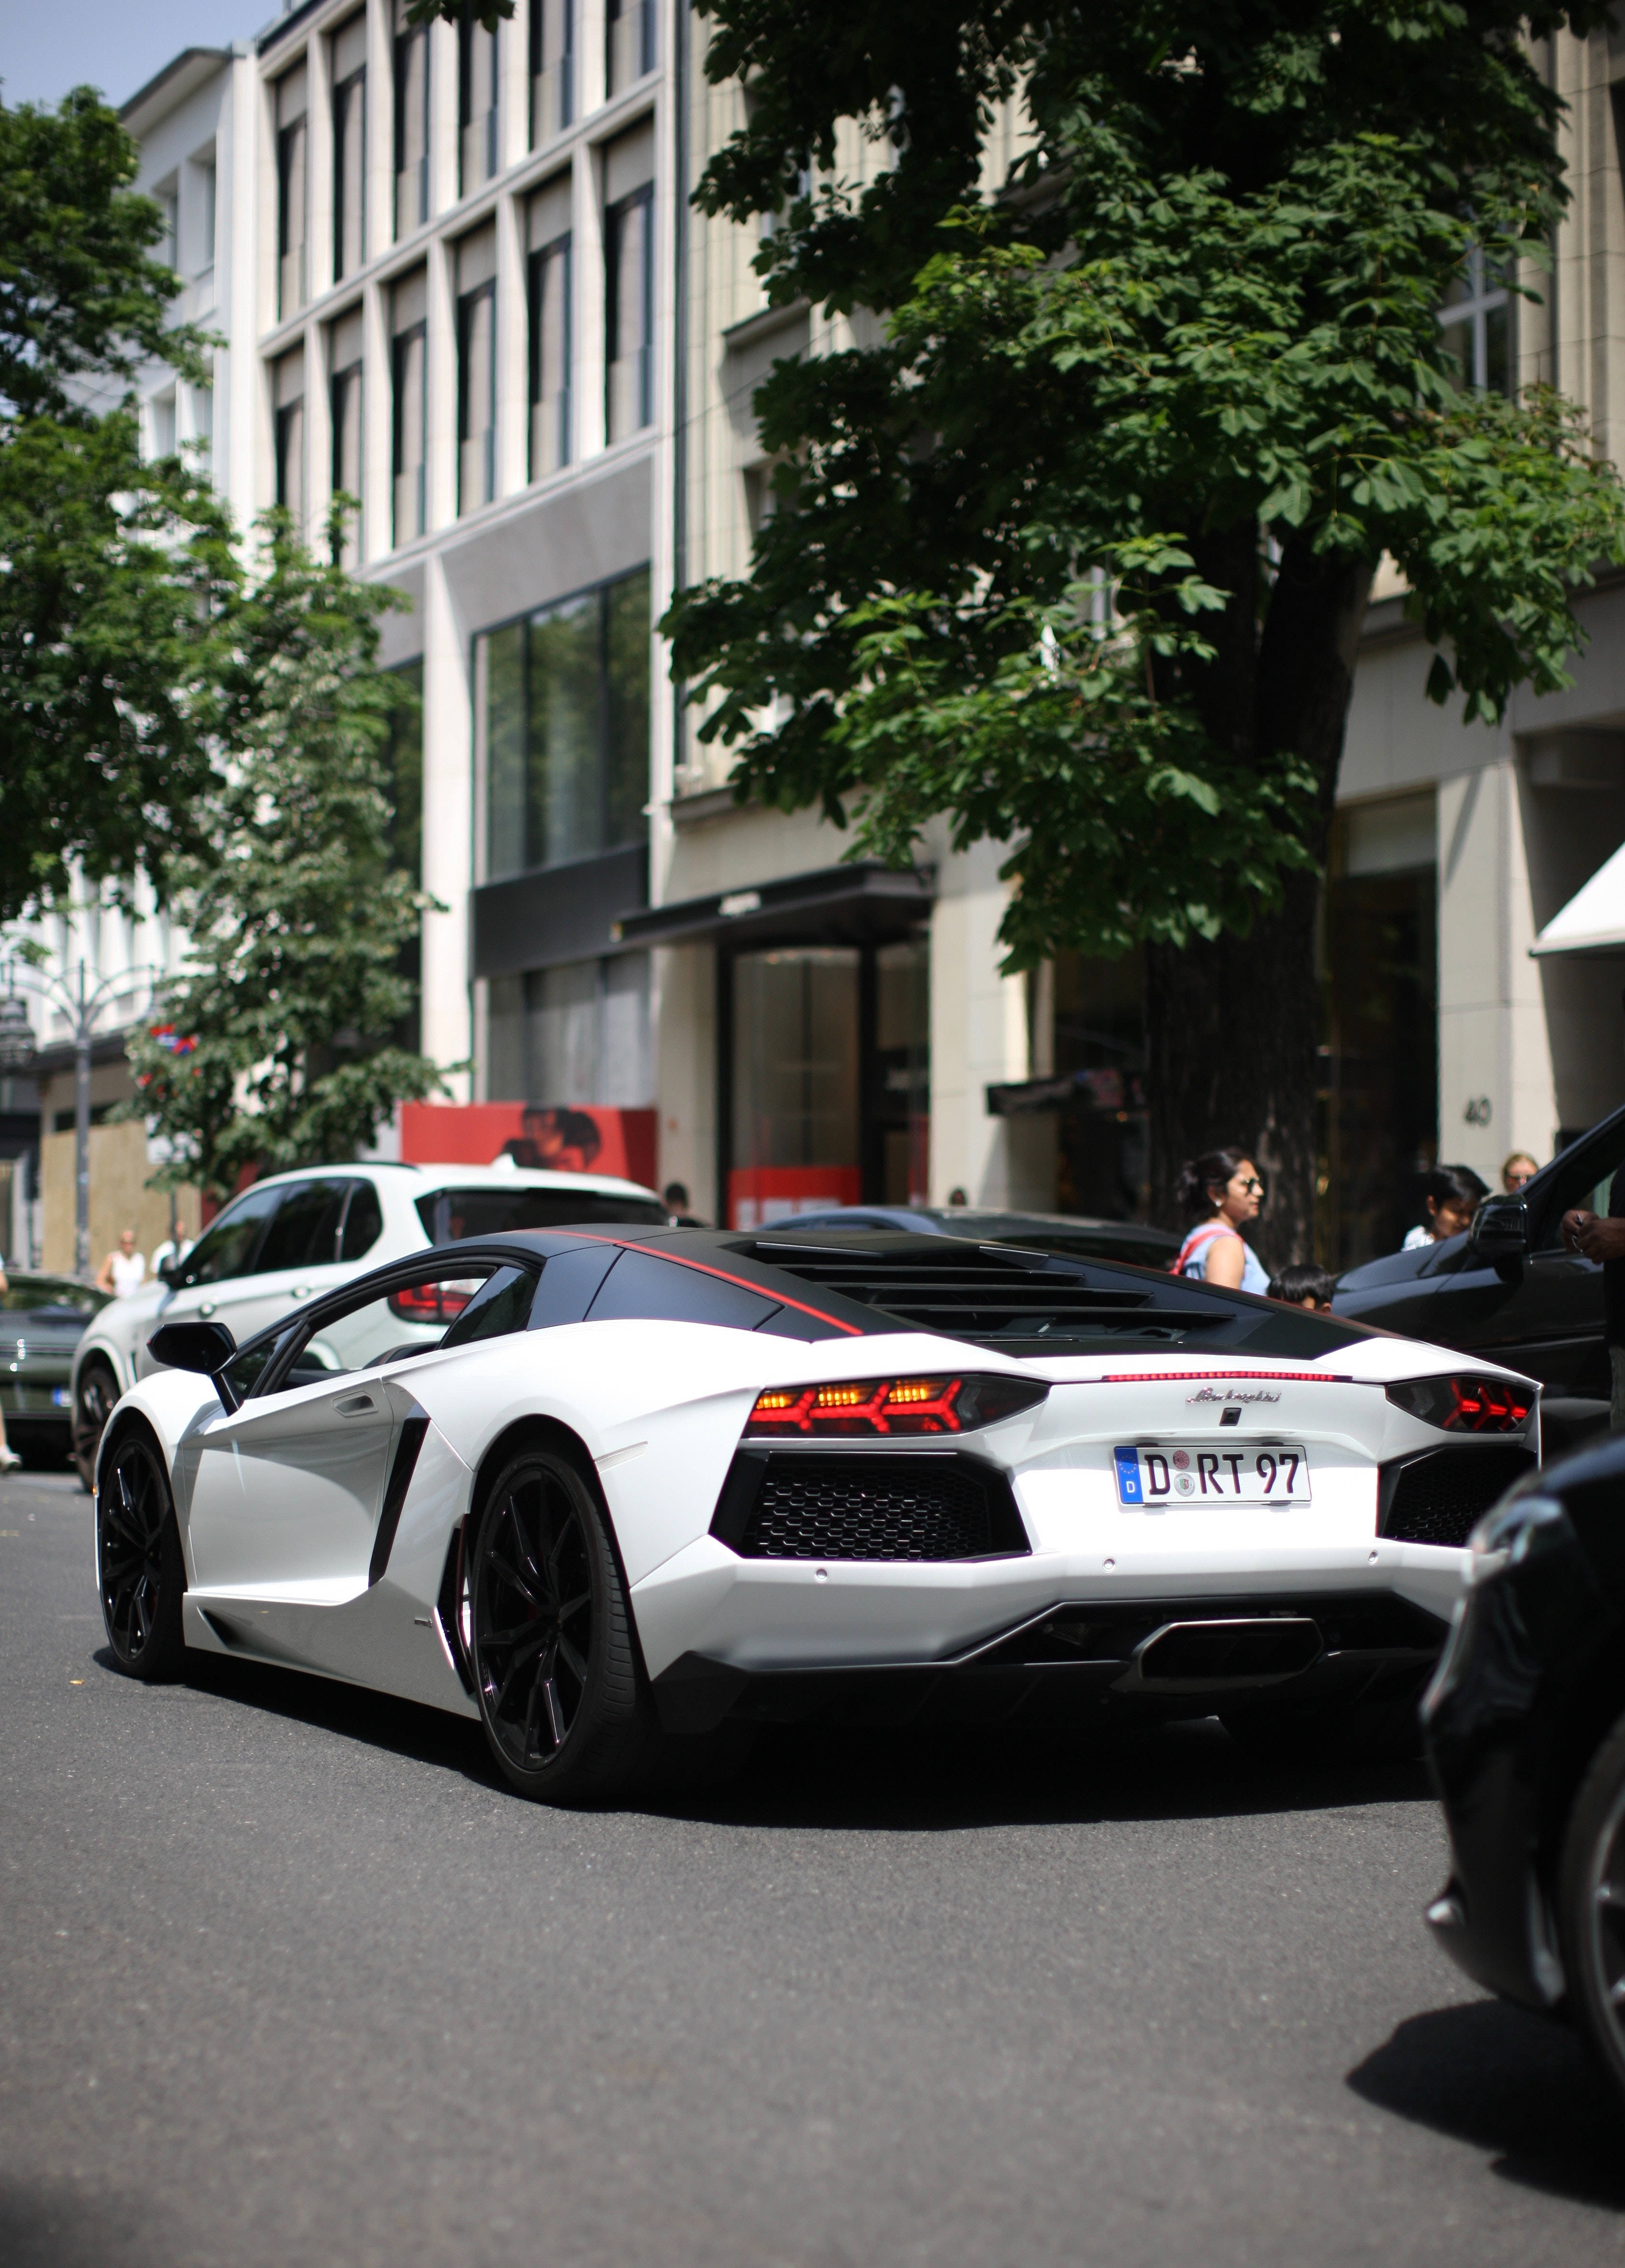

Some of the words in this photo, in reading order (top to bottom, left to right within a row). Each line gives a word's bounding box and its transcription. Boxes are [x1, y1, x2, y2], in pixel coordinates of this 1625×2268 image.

[1186, 1387, 1281, 1404] Lamborghini
[1144, 1454, 1170, 1495] D
[1197, 1453, 1245, 1494] RT
[1256, 1453, 1299, 1494] 97
[1127, 1481, 1136, 1493] D
